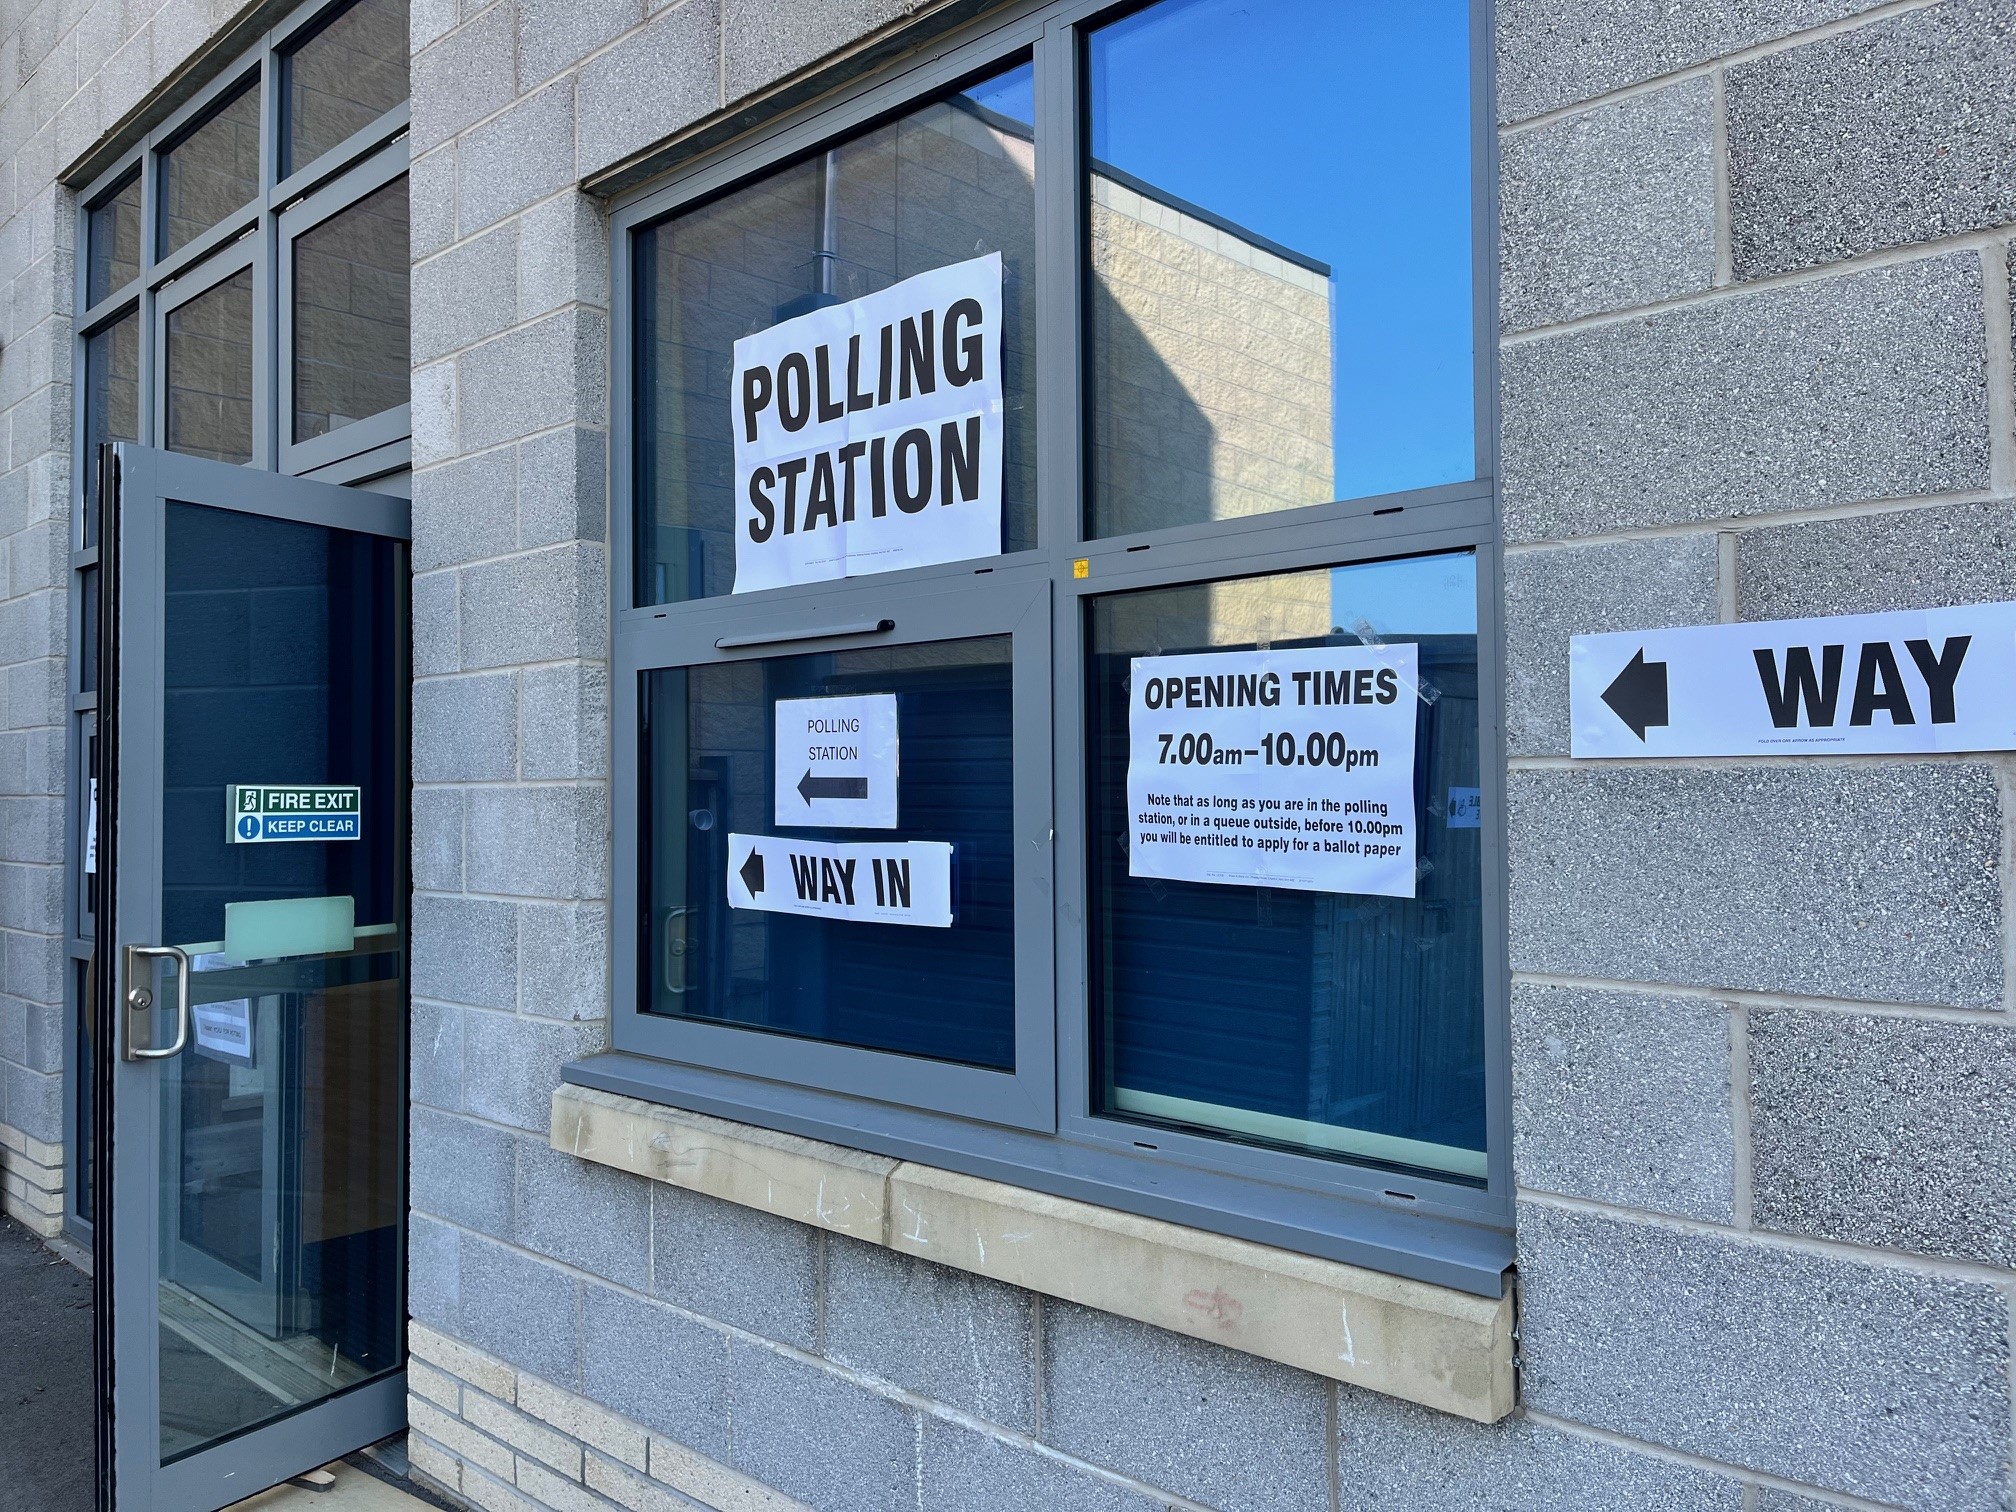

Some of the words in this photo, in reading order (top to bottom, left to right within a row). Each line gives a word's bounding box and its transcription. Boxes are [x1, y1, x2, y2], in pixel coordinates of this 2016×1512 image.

[742, 297, 984, 443] POLLING
[749, 415, 981, 544] STATION
[1144, 672, 1281, 710] OPENING
[1291, 668, 1398, 706] TIMES
[1752, 635, 1973, 729] WAY
[807, 718, 860, 734] POLLING
[808, 746, 858, 761] STATION
[268, 792, 311, 809] FIRE
[314, 793, 354, 809] EXIT
[1147, 793, 1171, 806] Note
[1173, 794, 1194, 807] that
[1196, 797, 1210, 808] as
[1213, 794, 1238, 812] long
[1241, 798, 1256, 810] as
[1258, 799, 1281, 813] you
[1284, 800, 1304, 811] are
[1307, 797, 1318, 812] in
[1321, 798, 1341, 813] the
[1344, 799, 1388, 818] polling
[268, 820, 306, 834] KEEP
[309, 819, 354, 833] CLEAR
[1138, 811, 1176, 828] station,
[1177, 815, 1188, 826] or
[1190, 813, 1200, 827] in
[1203, 816, 1210, 827] a
[1213, 817, 1250, 831] queue
[1253, 816, 1301, 834] outside,
[1304, 817, 1344, 833] before
[1347, 820, 1403, 838] 10.00pm
[1140, 832, 1158, 845] you
[1160, 830, 1177, 844] will
[1179, 831, 1192, 845] be
[1194, 833, 1239, 848] entitled
[1241, 835, 1254, 848] to
[1257, 836, 1290, 854] apply
[1292, 837, 1309, 851] for
[1312, 841, 1320, 852] a
[1324, 838, 1360, 854] ballot
[1363, 843, 1402, 859] paper
[789, 853, 857, 906] WAY
[871, 858, 911, 909] IN
